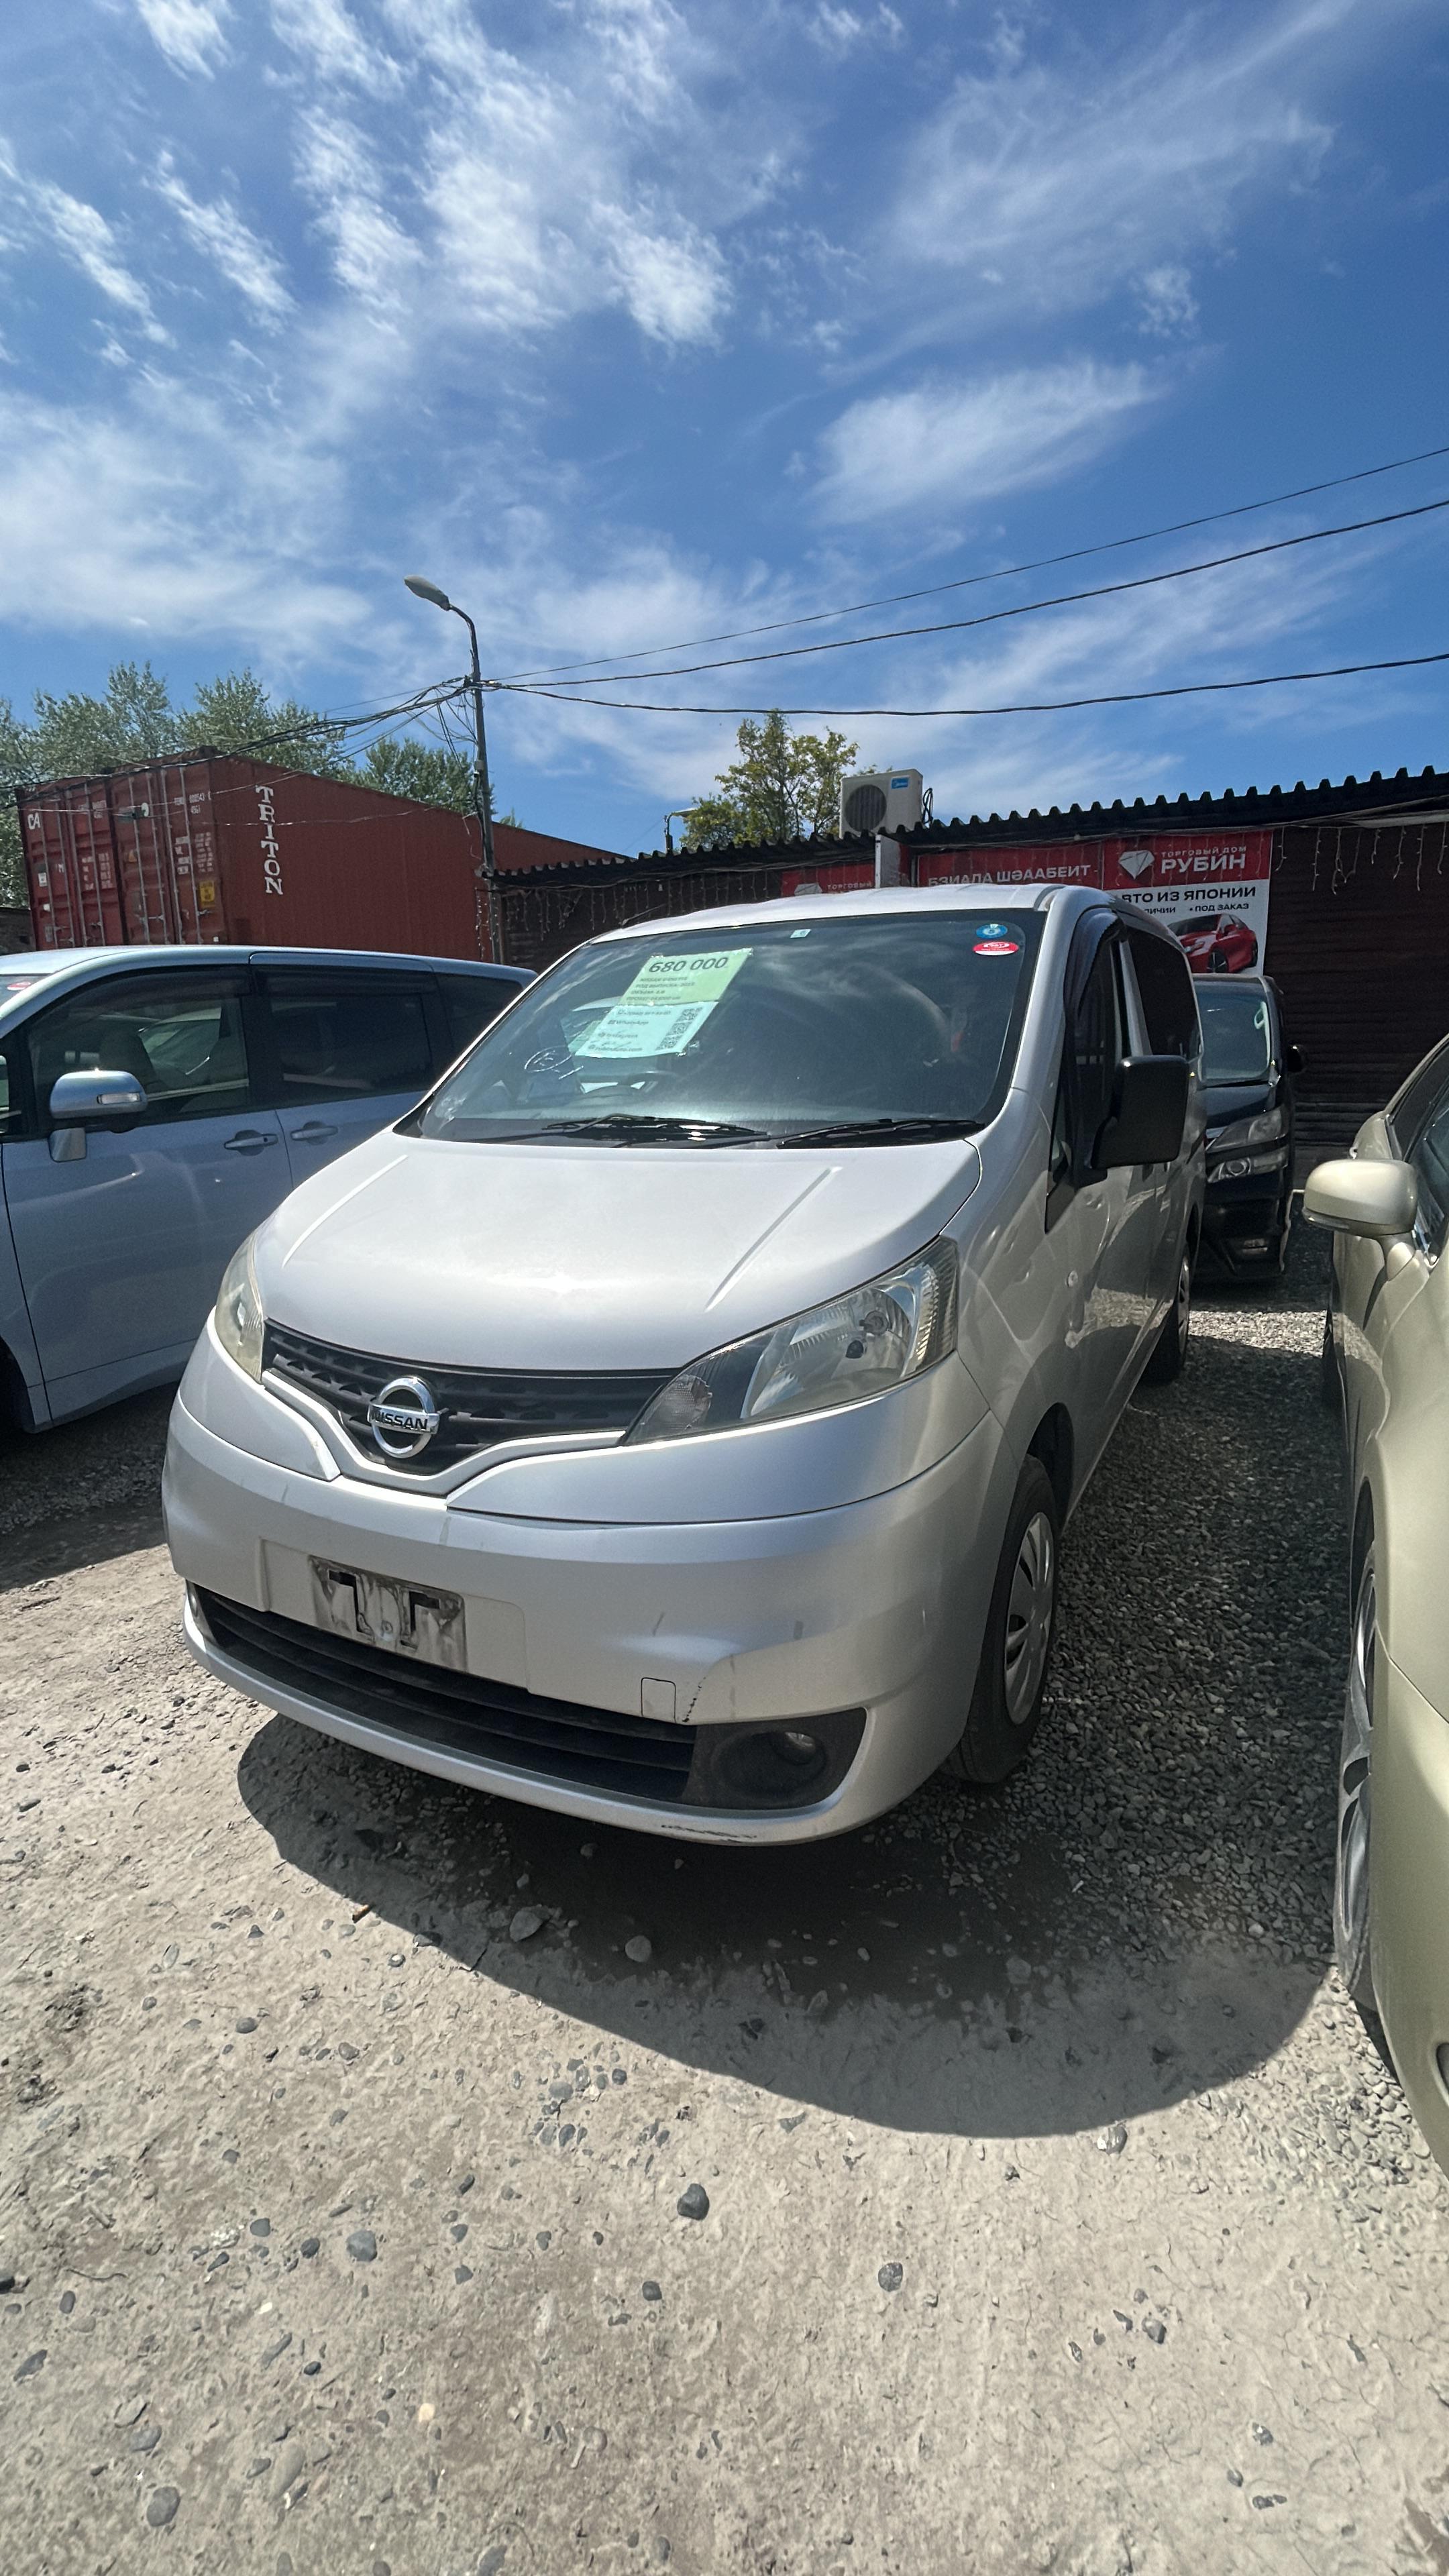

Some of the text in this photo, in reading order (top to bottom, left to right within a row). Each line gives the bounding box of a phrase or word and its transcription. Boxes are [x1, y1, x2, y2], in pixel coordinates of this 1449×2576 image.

[255, 785, 284, 896] TRITON
[1161, 847, 1219, 857] ТОРГОВЫЙ
[1161, 853, 1246, 873] РУБИН
[1122, 886, 1256, 904] ВТО ИЗ ЯПОНИИ
[649, 957, 729, 972] 680 000
[372, 1410, 428, 1431] NISSAN
